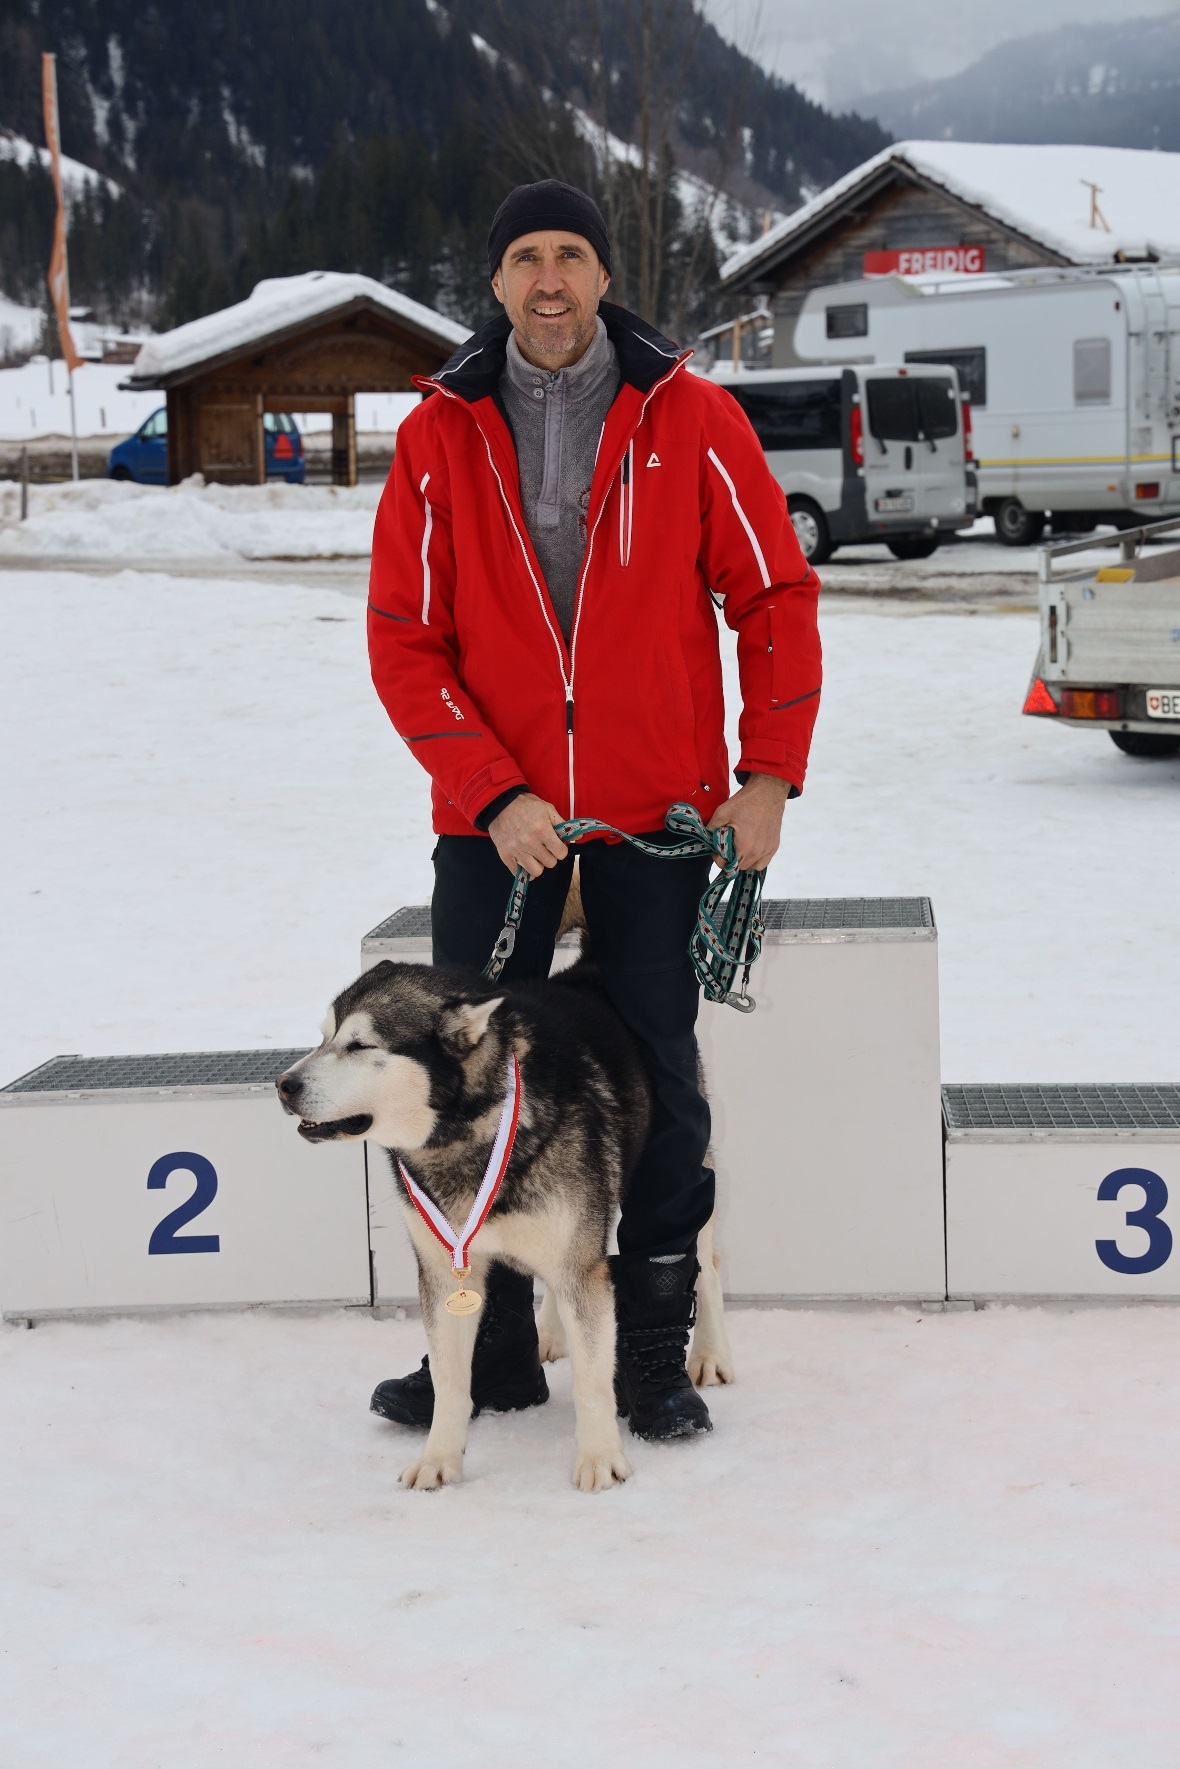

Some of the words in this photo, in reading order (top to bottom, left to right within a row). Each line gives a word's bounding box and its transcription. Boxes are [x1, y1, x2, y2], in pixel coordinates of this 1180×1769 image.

[899, 248, 980, 274] FREIDIG
[1161, 695, 1180, 715] BE
[147, 1151, 220, 1255] 2
[1095, 1167, 1173, 1275] 3
